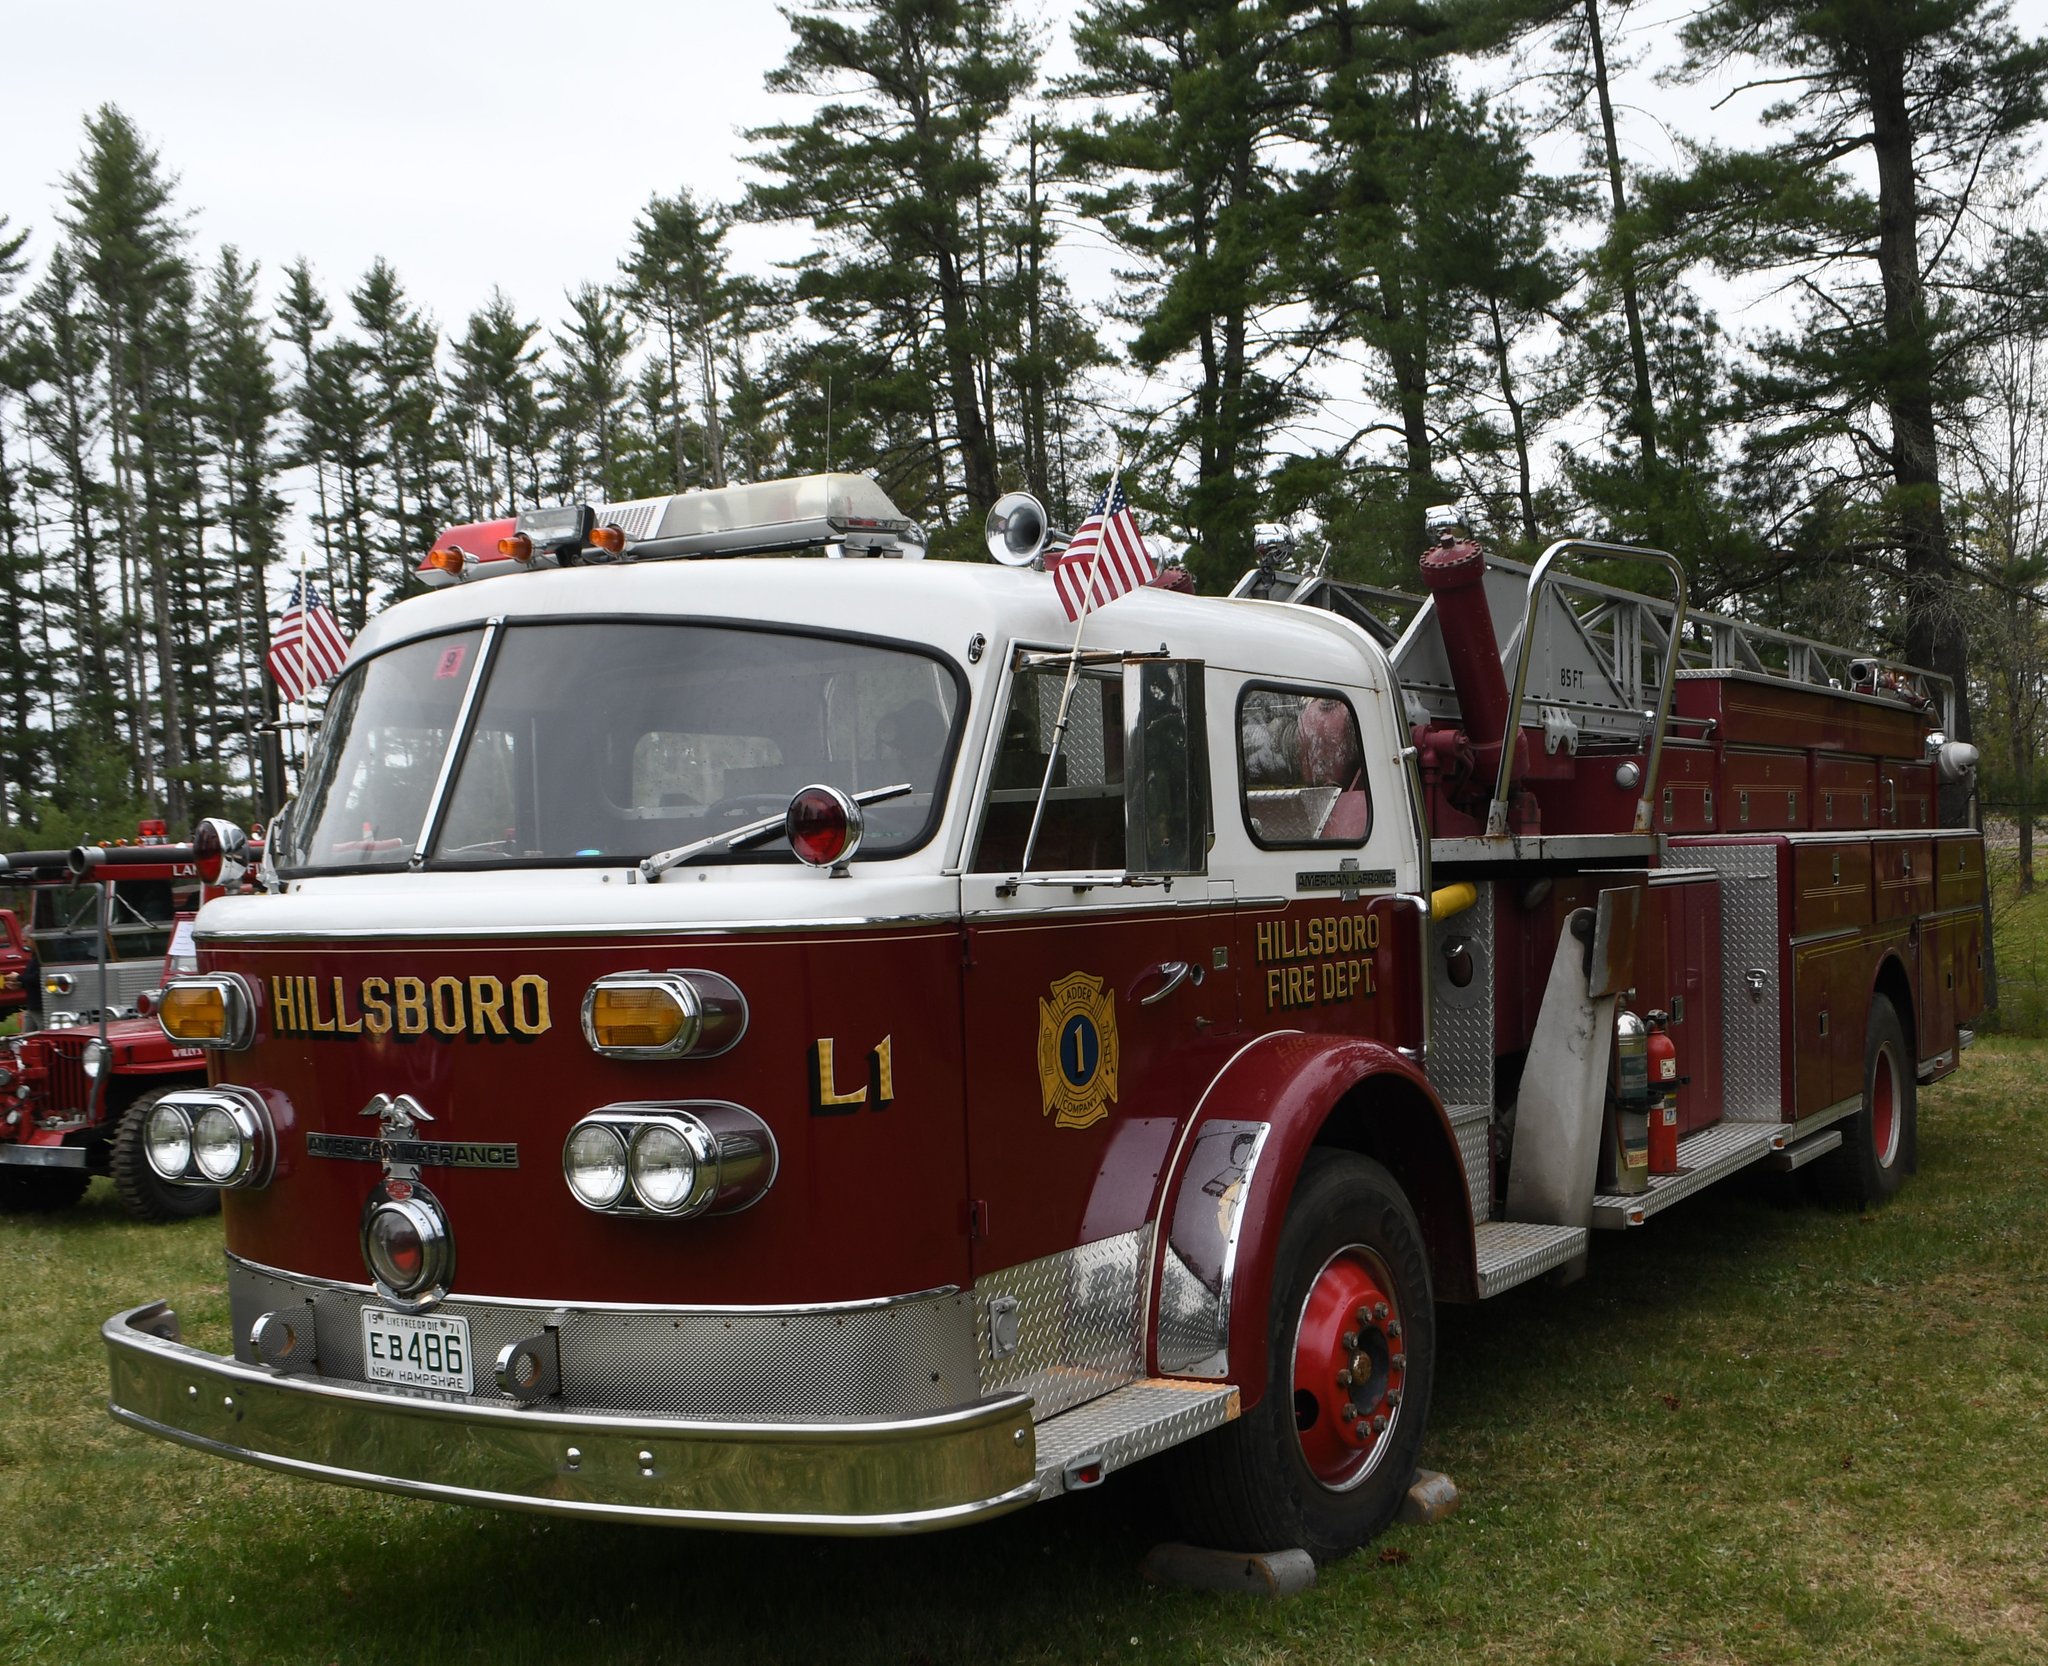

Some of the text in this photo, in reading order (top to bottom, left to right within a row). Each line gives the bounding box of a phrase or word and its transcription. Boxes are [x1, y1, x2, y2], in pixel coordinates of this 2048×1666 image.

[1560, 668, 1572, 687] 85
[1298, 873, 1350, 888] AMERICAN
[1257, 914, 1380, 961] HILLSBORO
[1061, 986, 1092, 1005] LADDER
[1267, 965, 1316, 1008] FIRE
[271, 974, 553, 1035] HILLSBORO
[1074, 1023, 1085, 1073] 1
[817, 1034, 895, 1106] L1
[1063, 1096, 1098, 1114] COMPANY
[309, 1136, 397, 1161] AMERICAN
[401, 1319, 416, 1329] FREE
[427, 1321, 439, 1332] DIE
[371, 1366, 464, 1390] NEW HAMPSHIRE
